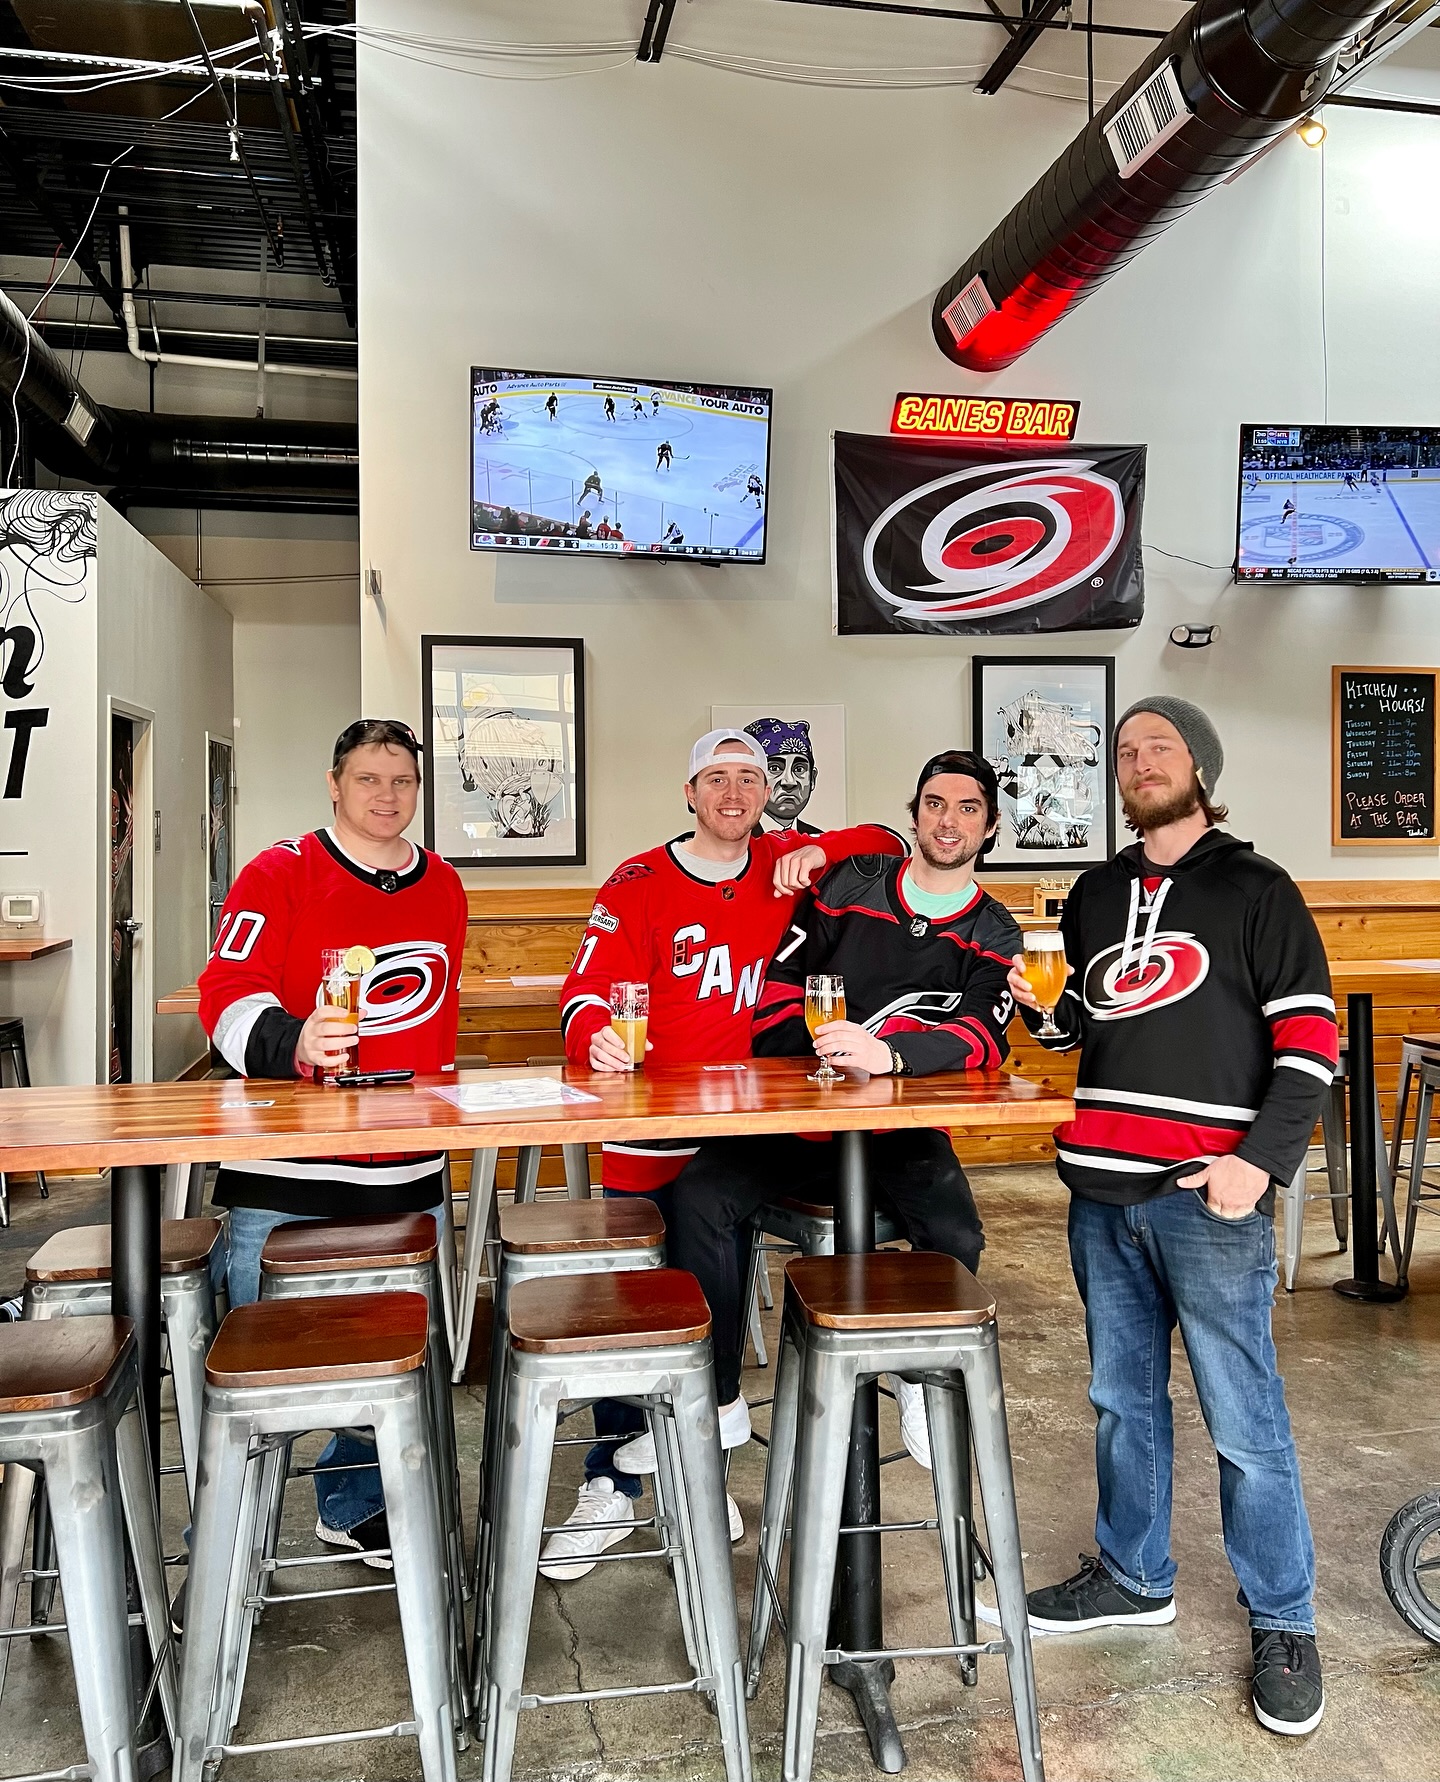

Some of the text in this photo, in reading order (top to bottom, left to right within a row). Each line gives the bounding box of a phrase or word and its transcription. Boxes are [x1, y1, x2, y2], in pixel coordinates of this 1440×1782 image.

[473, 384, 498, 397] AUTO
[699, 397, 729, 410] YOUR
[731, 402, 764, 415] AUTO
[897, 396, 1074, 436] CANES BAR
[1265, 472, 1295, 480] OFFICIAL
[1295, 472, 1337, 480] HEALTHCARE
[505, 537, 512, 545] 2
[558, 539, 566, 548] 3
[1346, 680, 1398, 699] KITCHEN
[1379, 697, 1426, 714] HOURS!
[1345, 719, 1372, 728] TUESDAY
[1346, 740, 1376, 748] THURSDAY
[1346, 750, 1369, 759] FRIDAY
[1346, 760, 1373, 768] SATURDAY
[1346, 771, 1370, 779] SUNDAY
[1346, 790, 1427, 811] PLEASE ORDER
[1350, 810, 1422, 826] AT THE BAR
[775, 924, 807, 963] 7
[571, 932, 599, 976] 1
[672, 922, 767, 1015] CAN
[992, 990, 1014, 1035] 3
